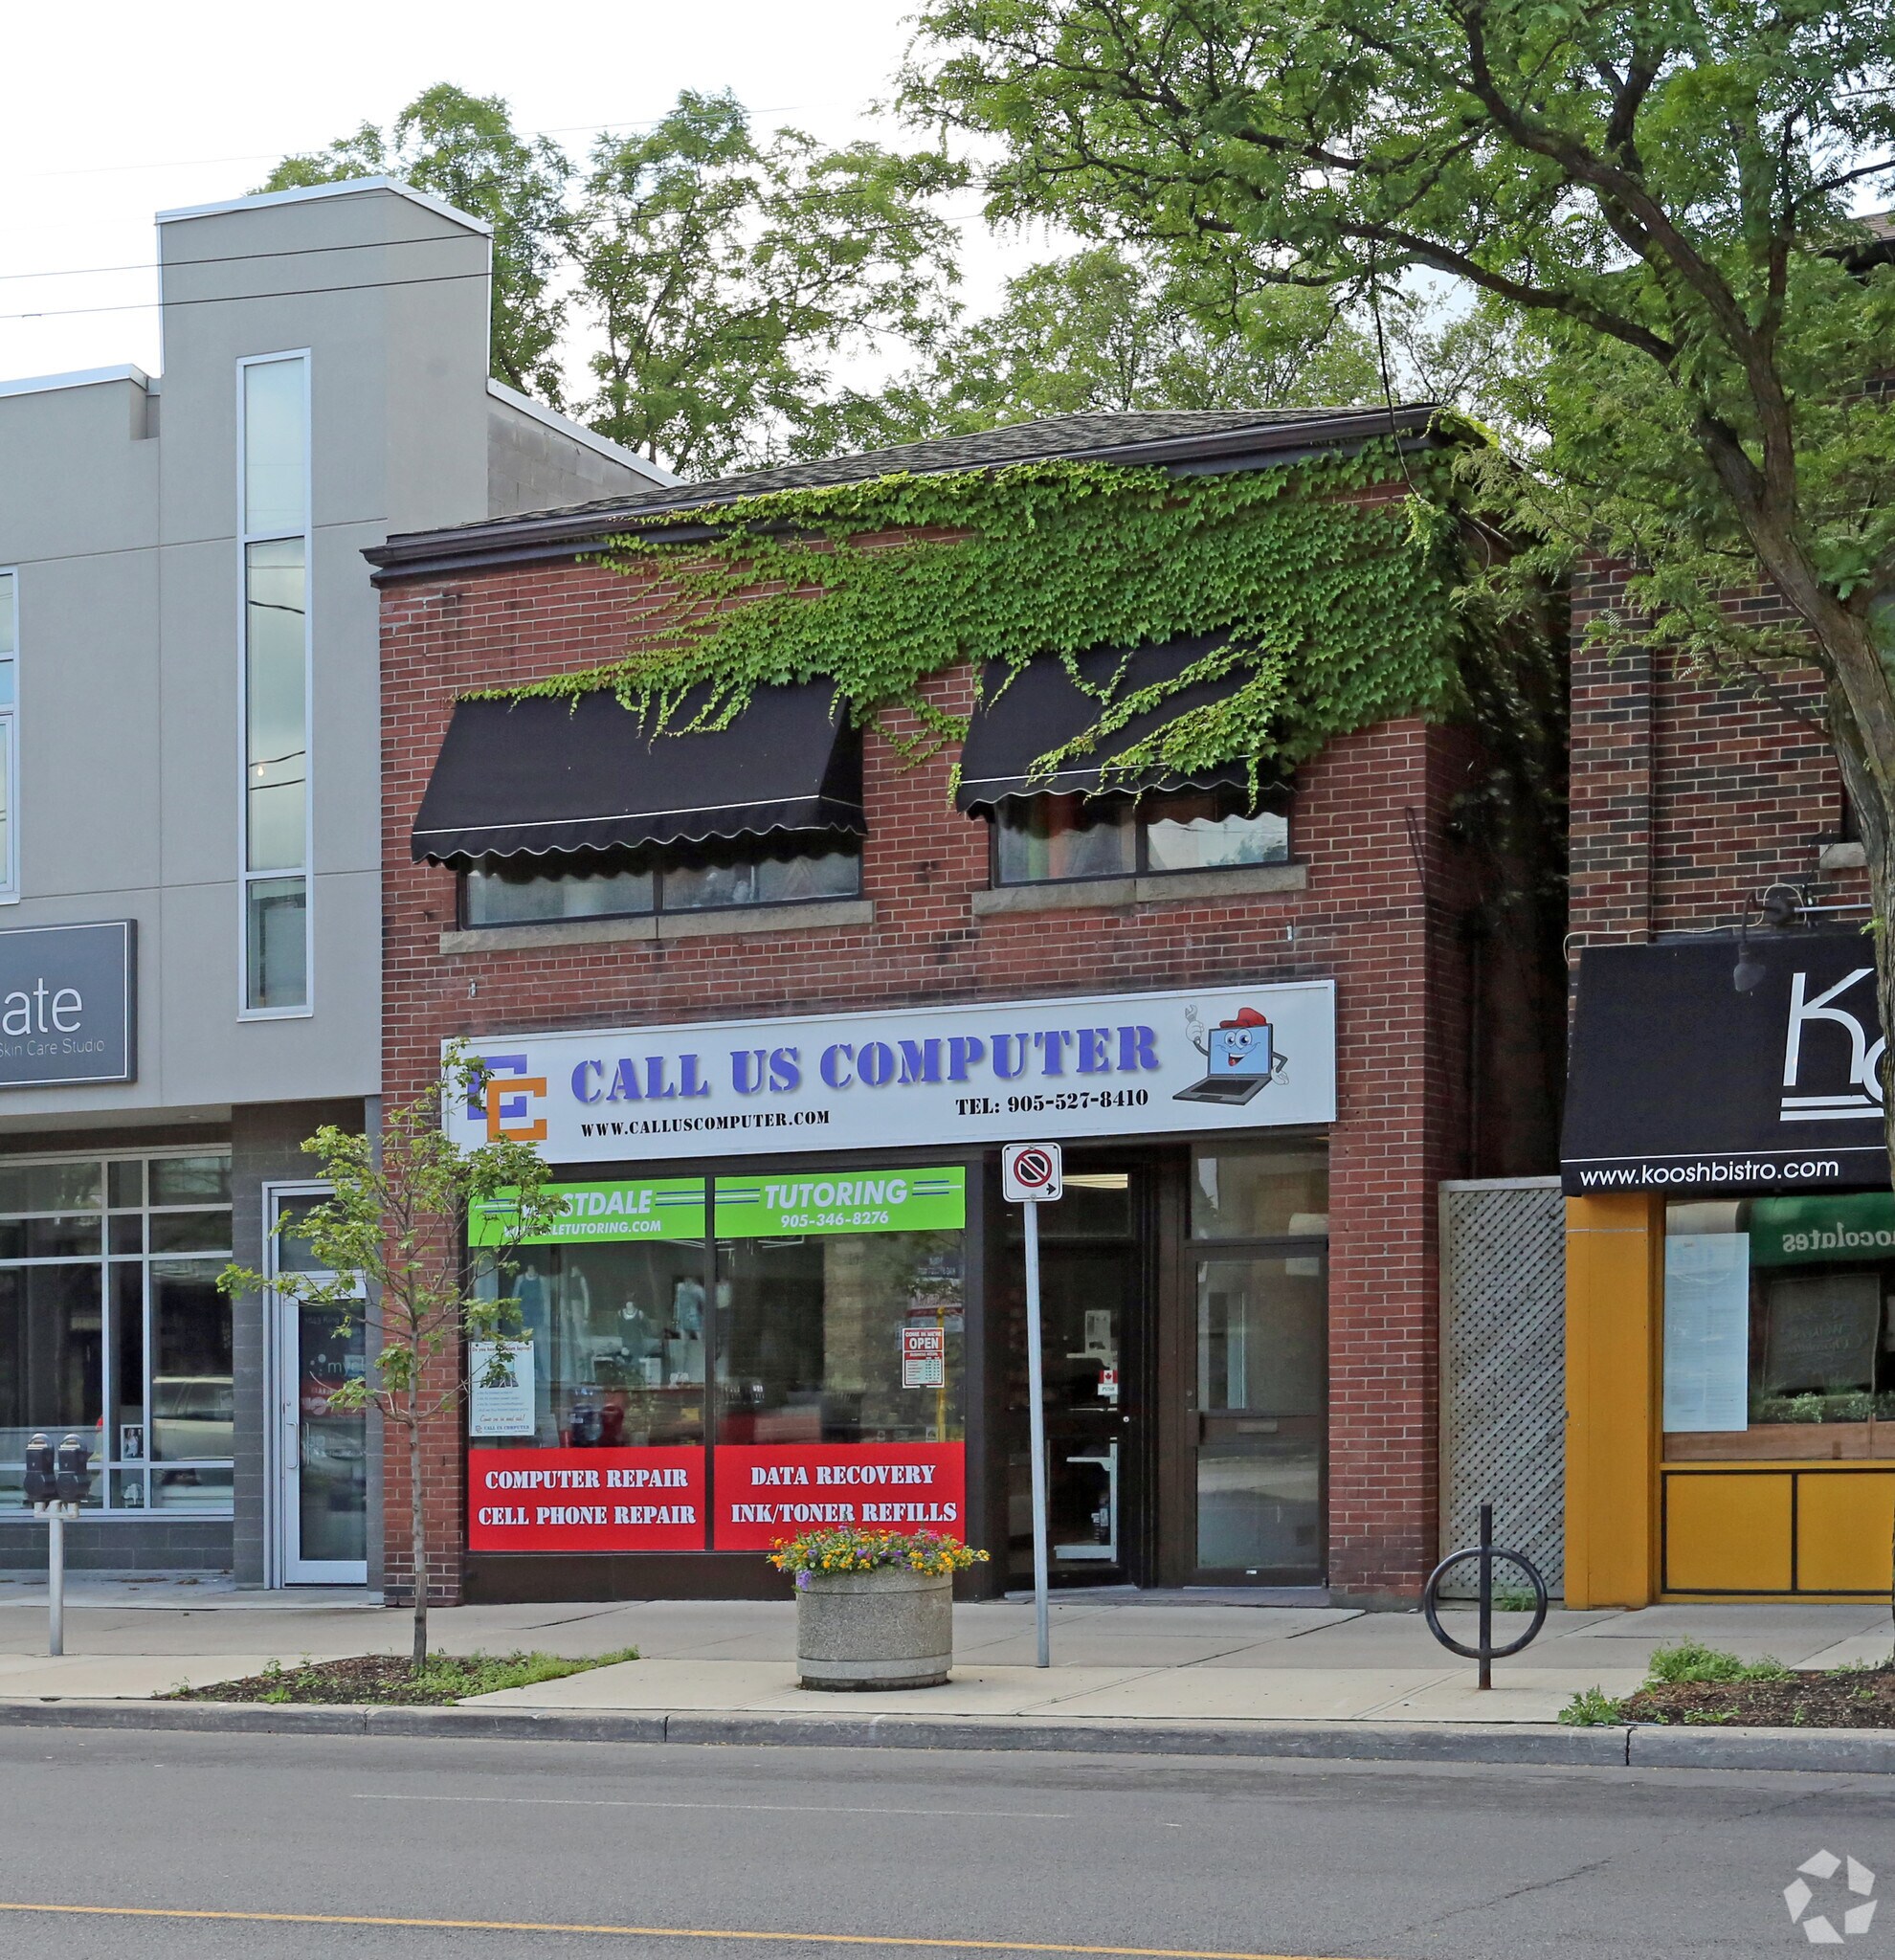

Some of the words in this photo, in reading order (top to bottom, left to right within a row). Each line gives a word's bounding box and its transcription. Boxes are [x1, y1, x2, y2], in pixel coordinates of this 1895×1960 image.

[2, 977, 82, 1036] ate
[27, 1039, 57, 1056] Care
[62, 1037, 105, 1055] Studio
[571, 1054, 708, 1103] CALL
[729, 1046, 801, 1095] US
[820, 1025, 1160, 1088] COMPUTER
[956, 1098, 1001, 1116] TEL:
[1008, 1089, 1148, 1114] 905-527-8410
[581, 1110, 831, 1137] WWW.CALLUSCOMPUTER.COM
[1579, 1160, 1839, 1187] www.kooshbistro.com
[765, 1178, 908, 1210] TUTORING
[780, 1211, 889, 1228] 905-346-8276
[909, 1337, 939, 1349] OPEN
[484, 1468, 601, 1489] COMPUTER
[606, 1467, 688, 1488] REPAIR
[750, 1466, 809, 1485] DATA
[815, 1464, 936, 1484] RECOVERY
[478, 1506, 530, 1526] CELL
[536, 1505, 608, 1526] PHONE
[613, 1504, 697, 1525] REPAIR
[731, 1503, 856, 1525] INK/TONER
[861, 1502, 957, 1523] REFILLS
